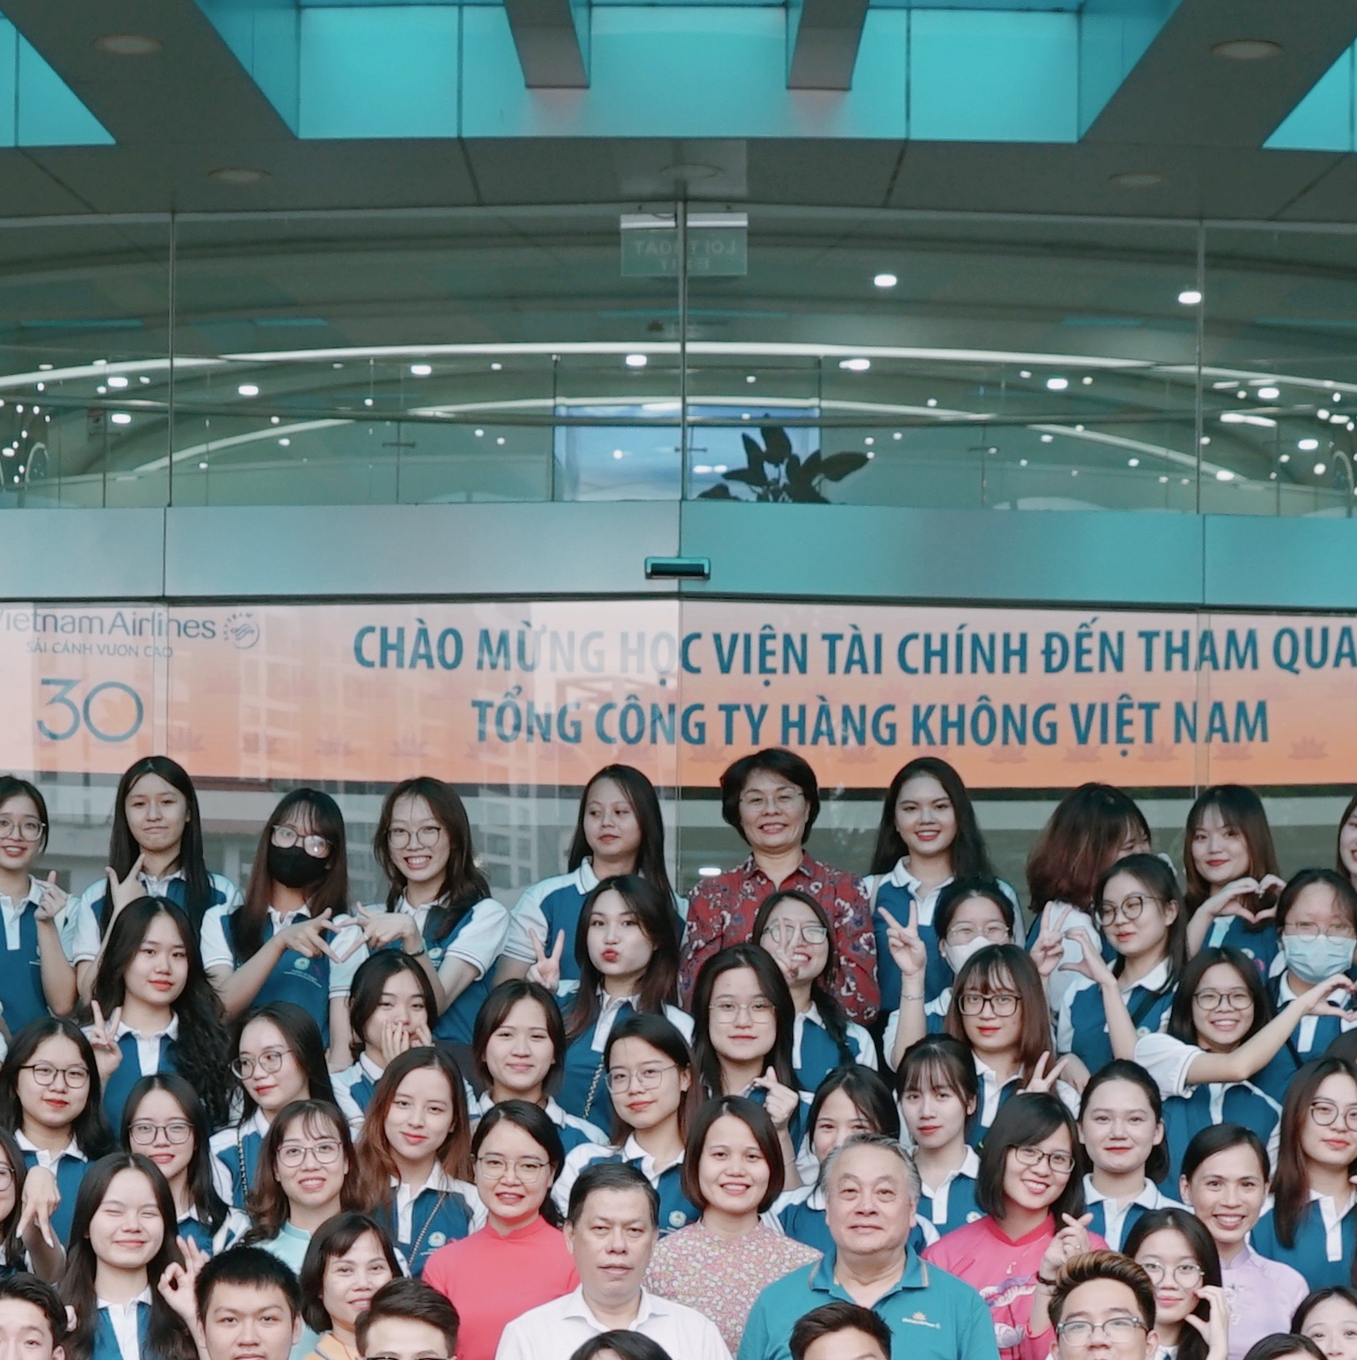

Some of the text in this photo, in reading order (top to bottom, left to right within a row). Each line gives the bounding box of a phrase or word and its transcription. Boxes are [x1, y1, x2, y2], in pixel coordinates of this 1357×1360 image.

[51, 639, 93, 656] CÁNH
[143, 645, 174, 659] CAO
[108, 609, 217, 640] Airlines
[353, 617, 464, 671] CHÀO
[476, 620, 604, 674] MỪNG
[619, 630, 703, 687] HỌC
[712, 624, 808, 687] VIỆN
[821, 623, 883, 675] TÀI
[897, 623, 1029, 675] CHÍNH
[1041, 617, 1125, 675] ĐẾN
[1137, 629, 1260, 673] THAM
[36, 677, 144, 743] 30
[471, 684, 1270, 757] TỔNG CÔNG TY HÀNG KHÔNG VIỆT NAM
